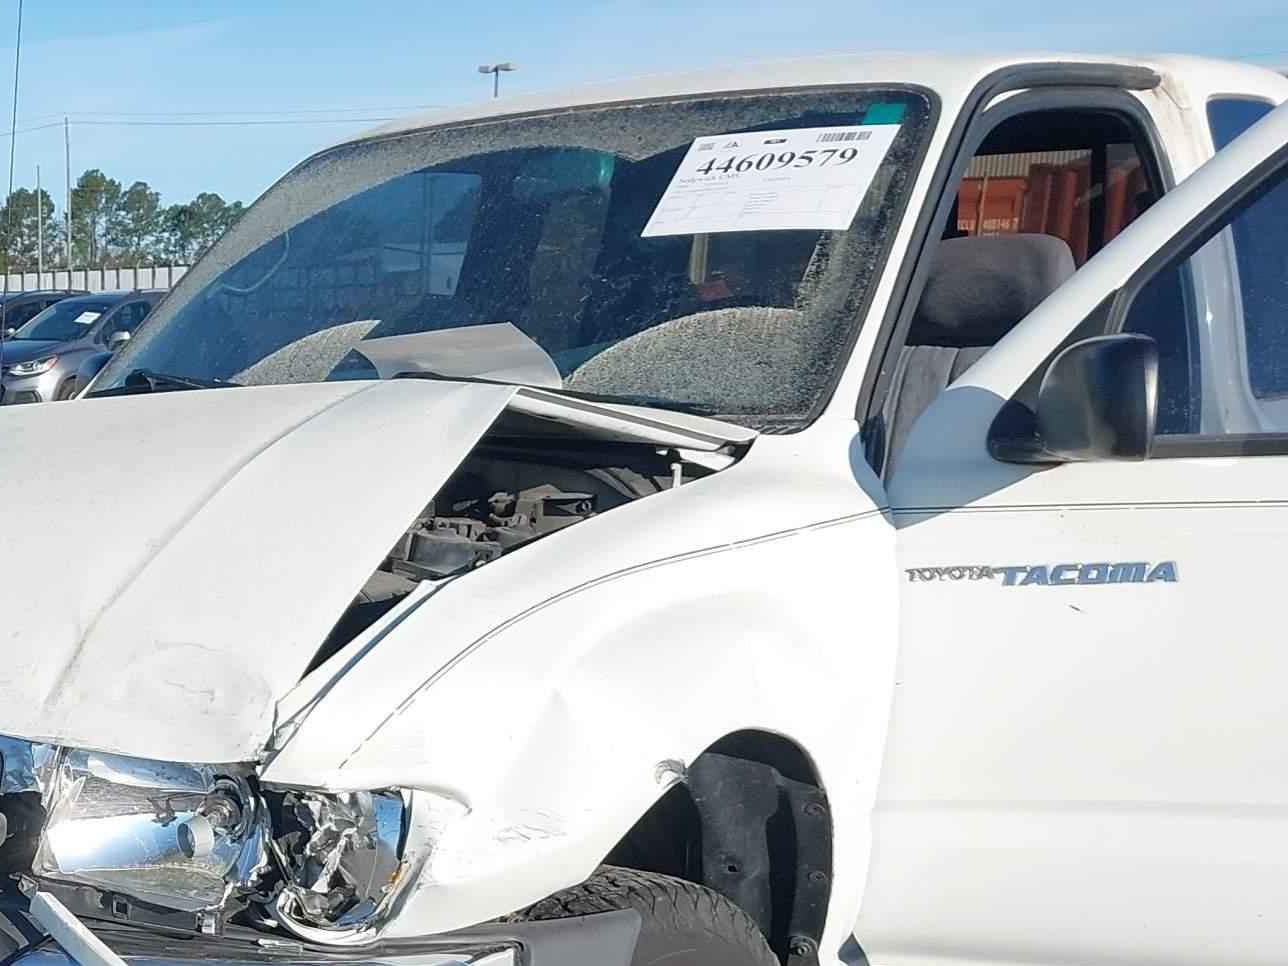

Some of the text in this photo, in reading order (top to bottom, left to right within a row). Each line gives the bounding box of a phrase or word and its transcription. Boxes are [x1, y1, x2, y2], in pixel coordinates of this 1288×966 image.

[696, 148, 859, 175] 44609579
[905, 560, 1179, 587] TOYOTA TACOMA
